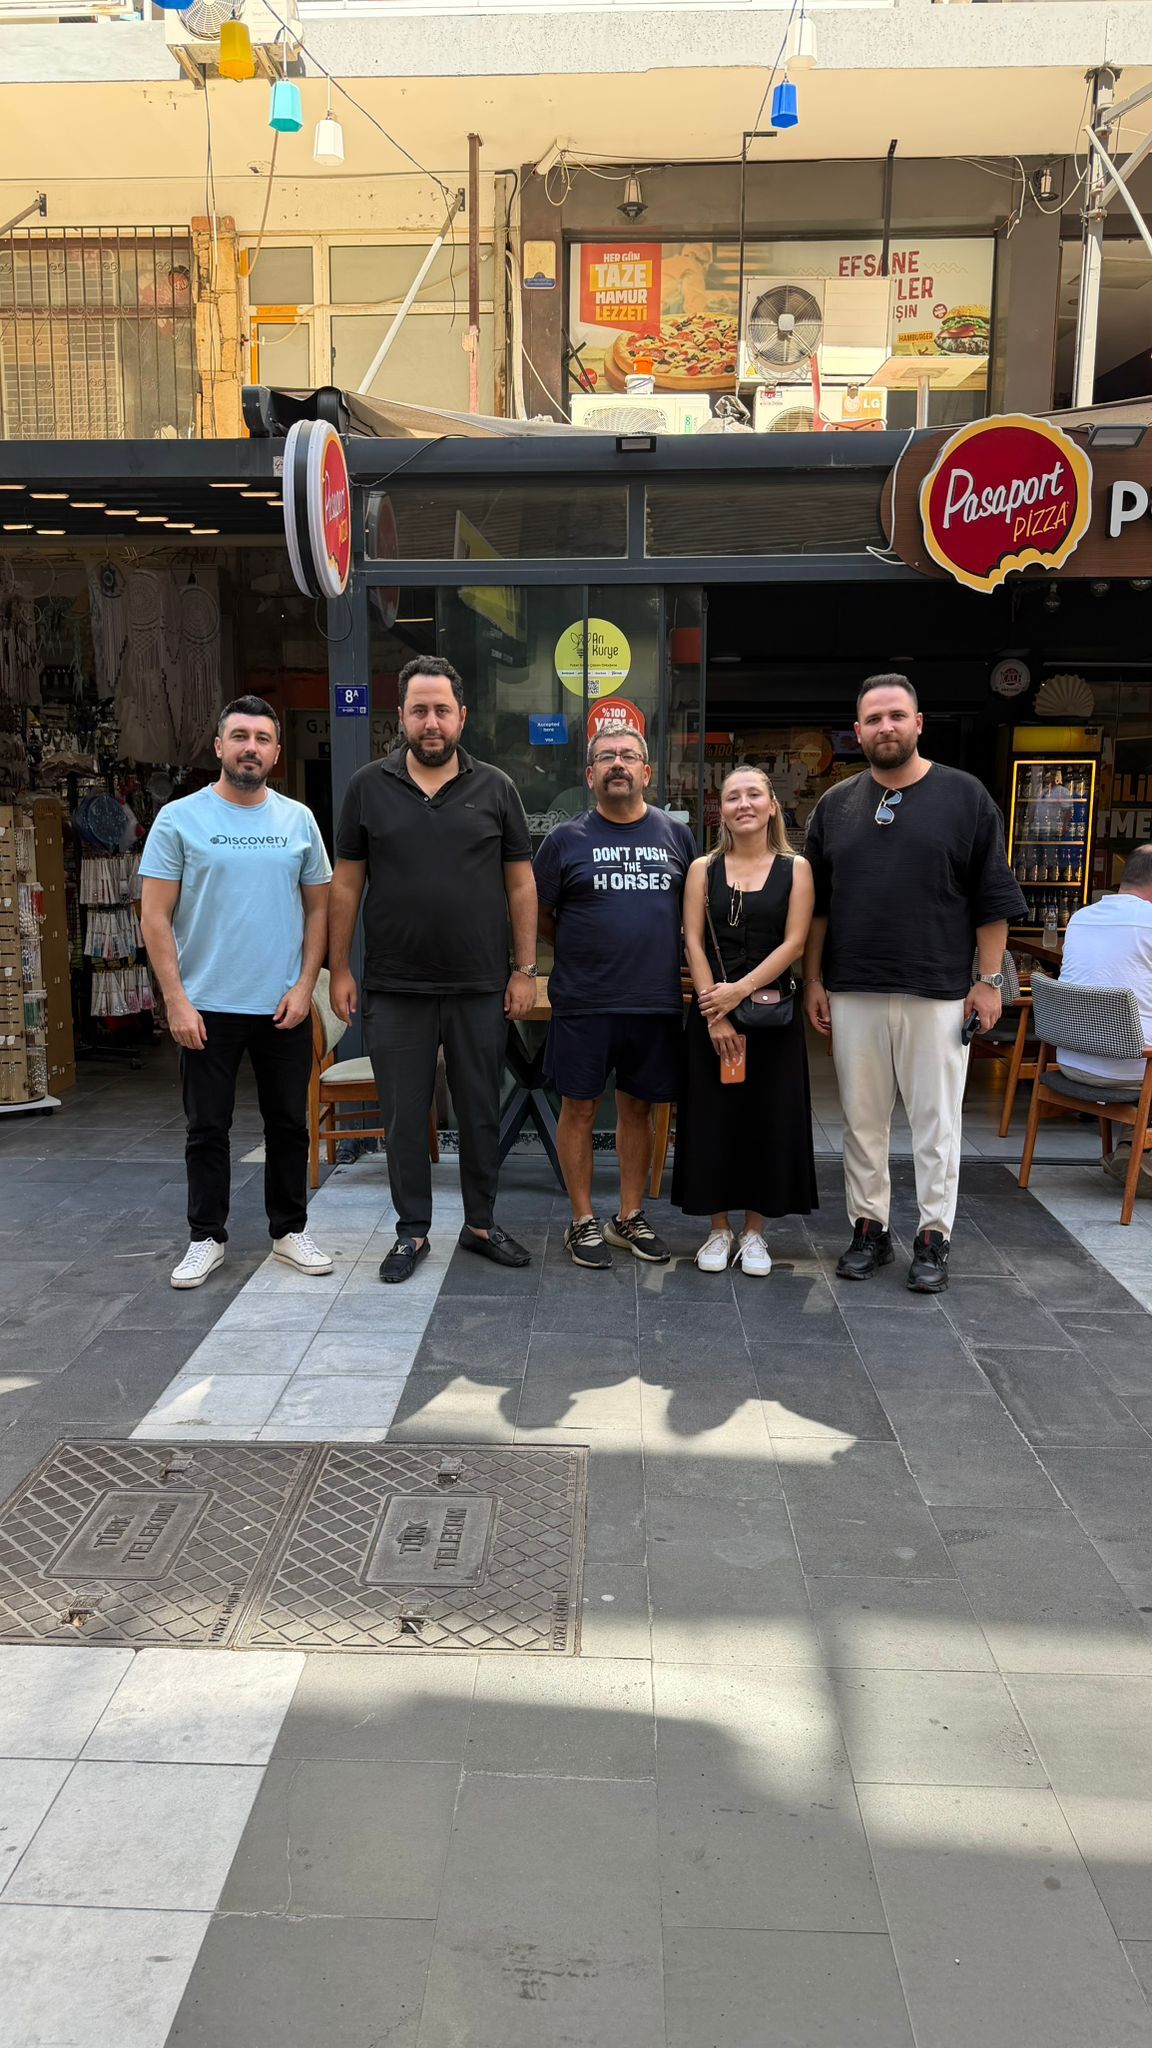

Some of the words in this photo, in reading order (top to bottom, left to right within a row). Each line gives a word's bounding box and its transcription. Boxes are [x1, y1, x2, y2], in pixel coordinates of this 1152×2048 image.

[603, 253, 620, 263] HER
[622, 251, 640, 262] GÜN
[594, 263, 646, 288] TAZE
[895, 277, 934, 300] LER
[595, 289, 648, 305] HAMUR
[898, 332, 934, 343] HAMBURGER
[863, 397, 881, 409] LG
[942, 461, 1065, 529] Pasaport
[1109, 480, 1152, 538] P
[592, 645, 619, 659] Kurye
[602, 707, 627, 718] %100
[537, 721, 560, 729] Accepted
[216, 834, 288, 847] Discovery
[592, 846, 631, 862] DON'T
[634, 846, 669, 862] PUSH
[623, 861, 642, 872] THE
[593, 872, 672, 890] HORSES
[93, 1514, 136, 1548] TÜRK
[121, 1502, 179, 1563] TELEKOM
[396, 1520, 429, 1555] TÜRK
[433, 1507, 468, 1570] TELEKOM
